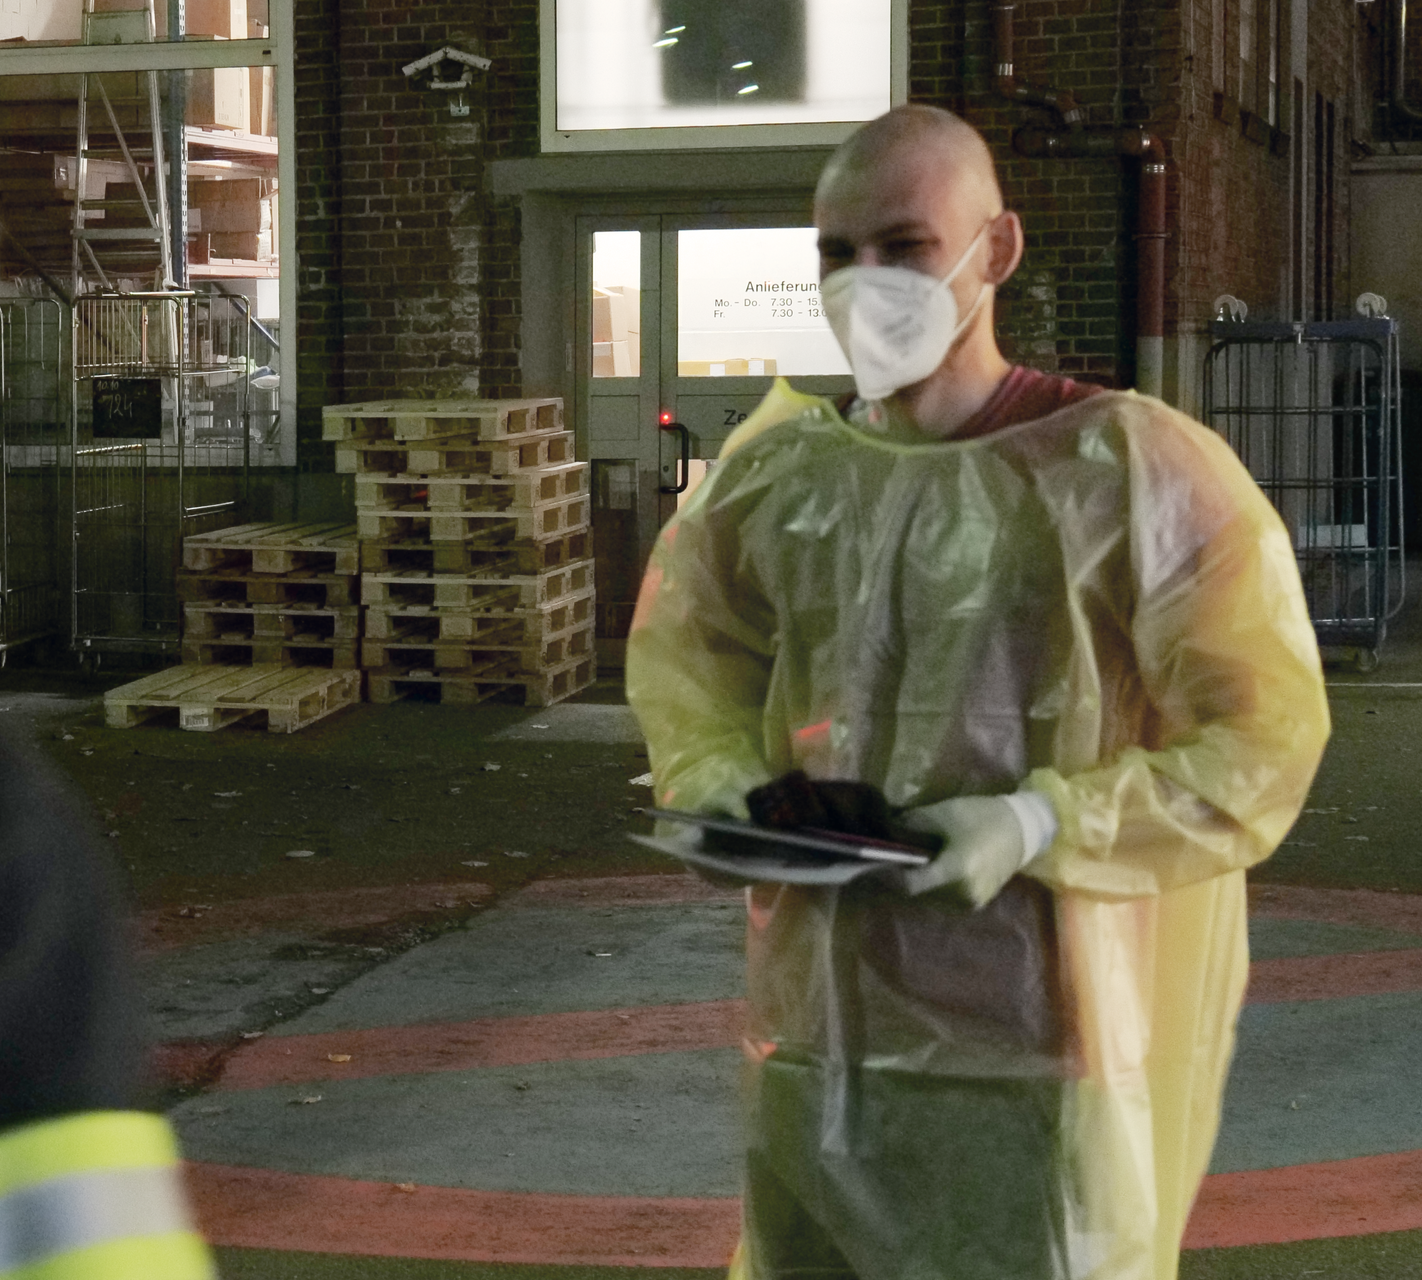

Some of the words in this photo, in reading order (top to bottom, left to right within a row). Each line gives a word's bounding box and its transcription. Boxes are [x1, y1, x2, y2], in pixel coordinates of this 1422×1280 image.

[744, 298, 760, 307] Do.
[771, 298, 793, 306] 7.30
[714, 309, 725, 318] Fr.
[771, 308, 793, 317] 7.30
